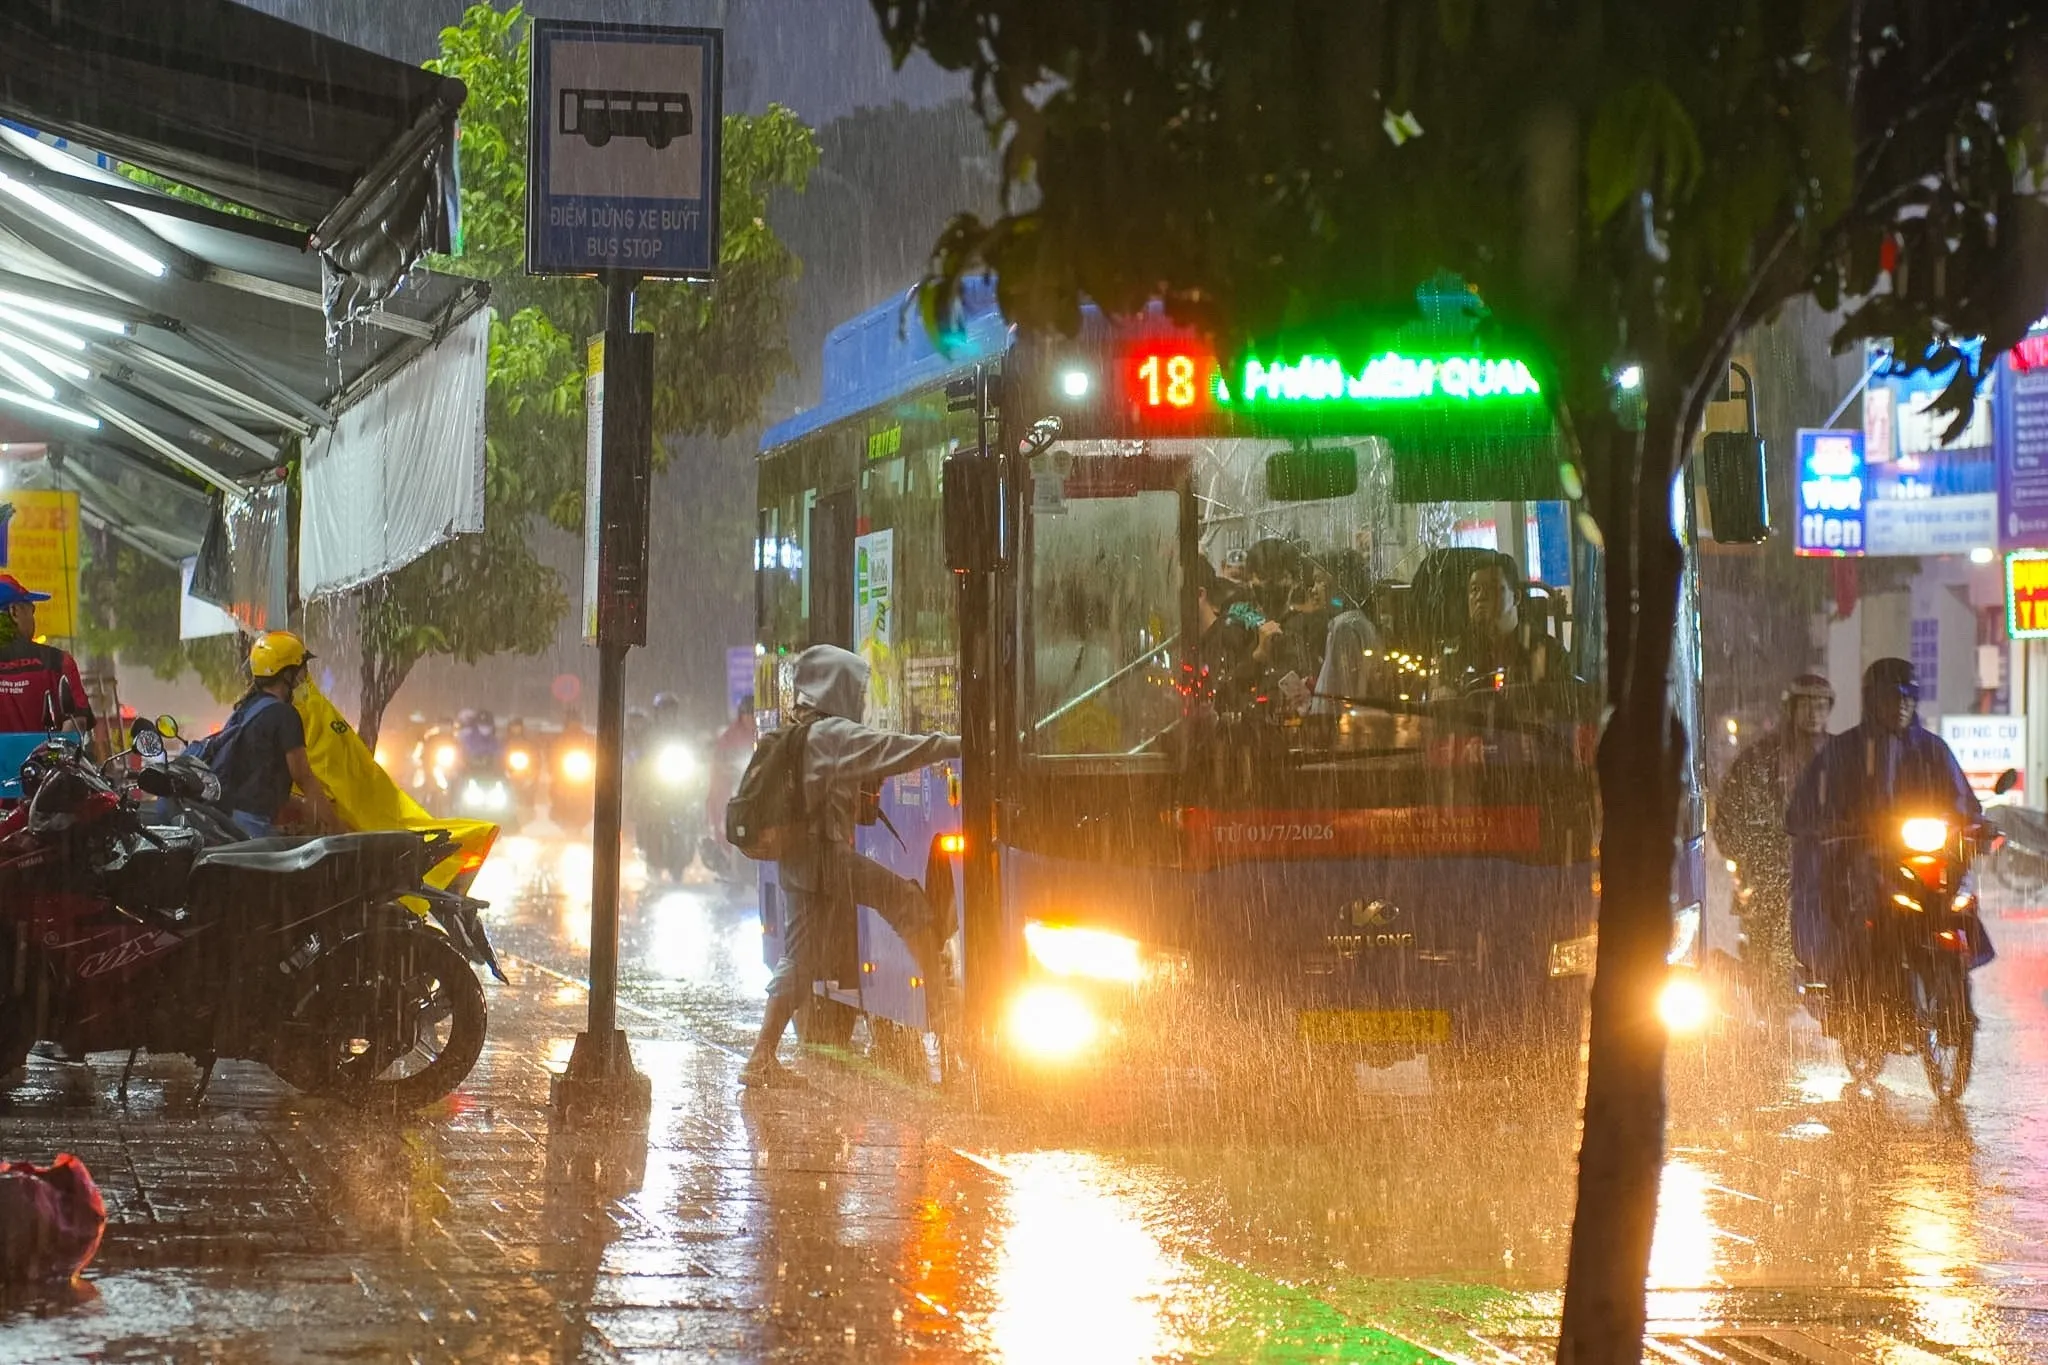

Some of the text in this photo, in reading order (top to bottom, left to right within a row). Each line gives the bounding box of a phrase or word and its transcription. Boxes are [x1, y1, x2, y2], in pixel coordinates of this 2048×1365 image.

[550, 198, 700, 231] ĐIỂM DỪNG XE BUÝT
[587, 237, 662, 258] BUS STOP
[1139, 354, 1195, 406] 18
[0, 658, 42, 669] ONDA
[1247, 822, 1335, 843] 01/7/2026
[1366, 933, 1415, 948] LONG
